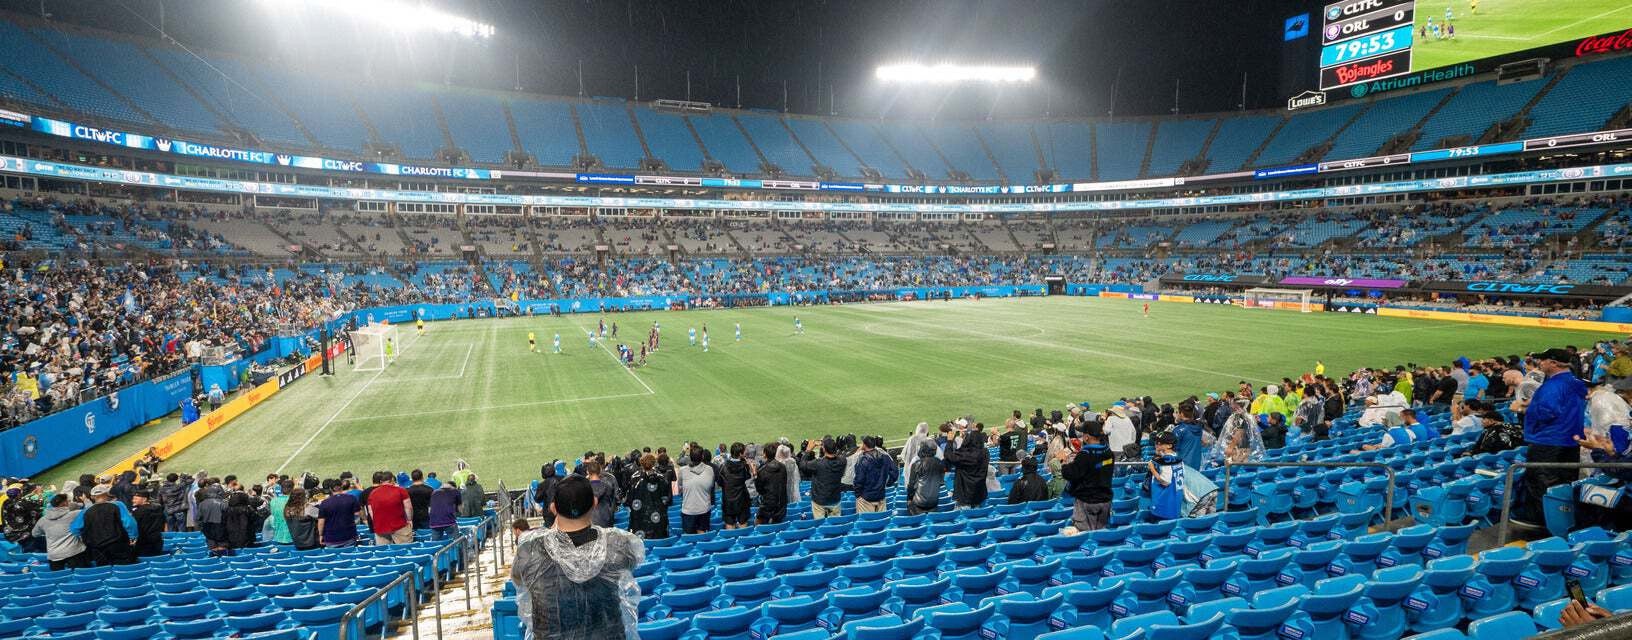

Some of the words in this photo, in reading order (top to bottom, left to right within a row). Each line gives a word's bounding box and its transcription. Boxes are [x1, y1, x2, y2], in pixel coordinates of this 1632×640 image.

[1342, 20, 1370, 34] ORL
[1394, 10, 1405, 21] 0
[1335, 32, 1396, 61] 79:53
[1335, 59, 1393, 84] Bojangles
[1370, 75, 1422, 93] Atrium
[1423, 63, 1475, 82] Health
[1291, 95, 1322, 109] LOWE'S
[1592, 132, 1617, 142] ORL
[187, 144, 248, 160] CHARLOTTE
[250, 152, 264, 161] FC
[1449, 146, 1479, 158] 79:53
[402, 166, 451, 177] CHARLOTTE
[453, 168, 463, 177] FC
